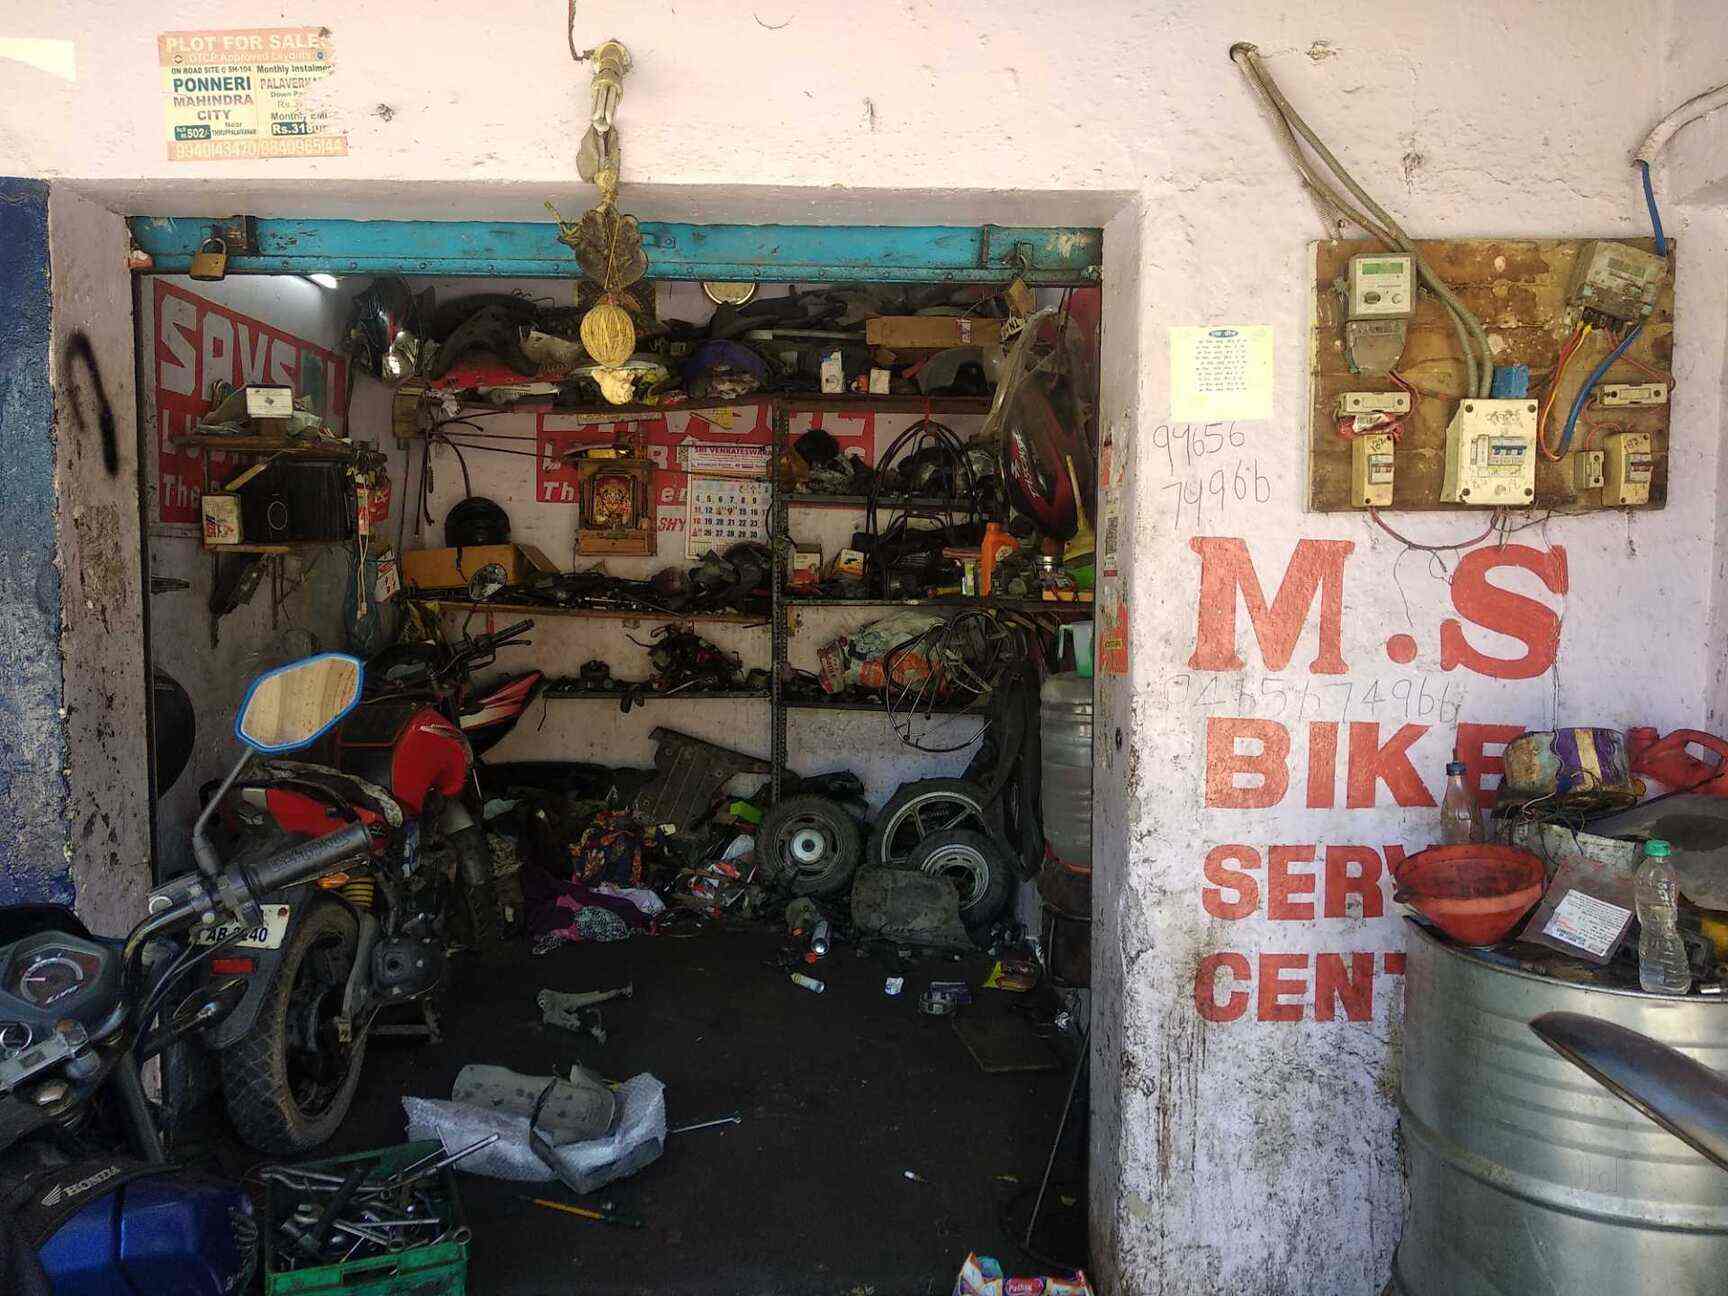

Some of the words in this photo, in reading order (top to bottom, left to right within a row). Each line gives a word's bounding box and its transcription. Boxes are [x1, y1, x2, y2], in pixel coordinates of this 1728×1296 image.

[166, 37, 217, 53] PLOT
[224, 36, 264, 50] FOR
[271, 34, 319, 48] SALE
[256, 65, 290, 76] Monthly
[173, 76, 252, 92] PONNERI
[173, 94, 254, 107] MAHINDRA
[196, 109, 232, 121] CITY
